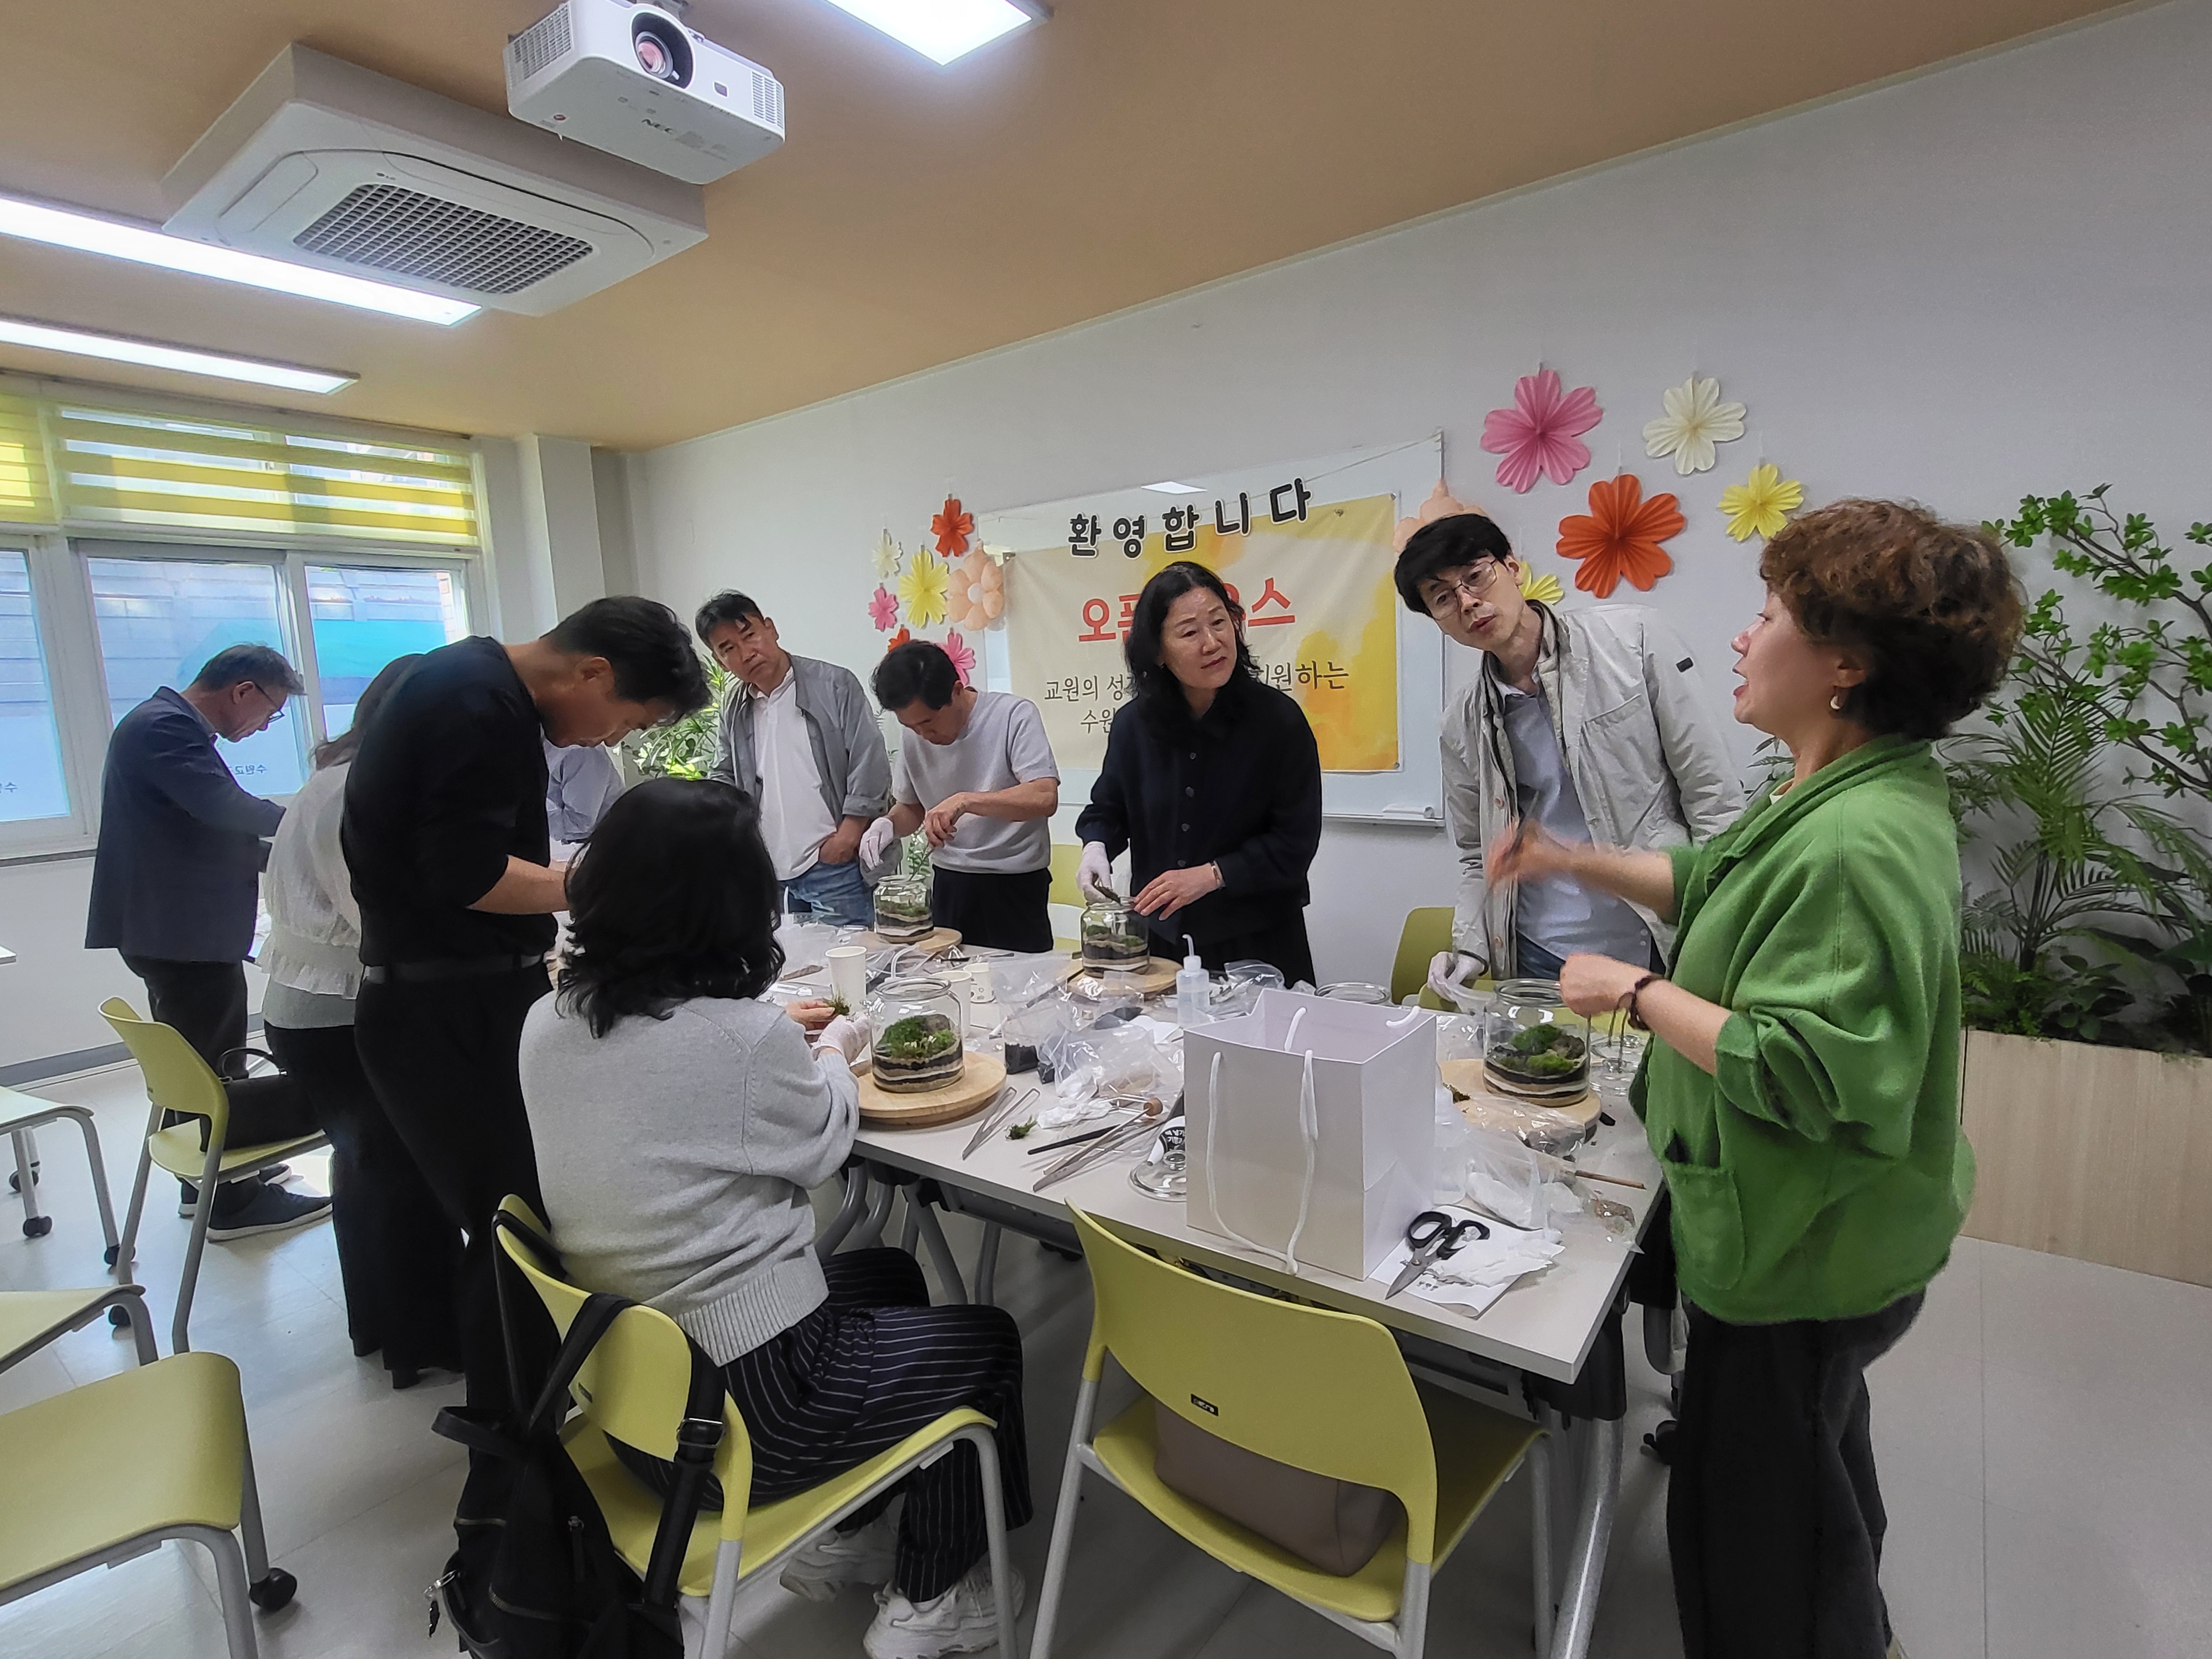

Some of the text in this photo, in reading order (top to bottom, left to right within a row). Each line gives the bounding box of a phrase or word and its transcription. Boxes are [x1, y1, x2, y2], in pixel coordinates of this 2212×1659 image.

[641, 118, 675, 135] NEC
[1068, 477, 1312, 559] 환영합니다
[1044, 675, 1098, 702] 교원의
